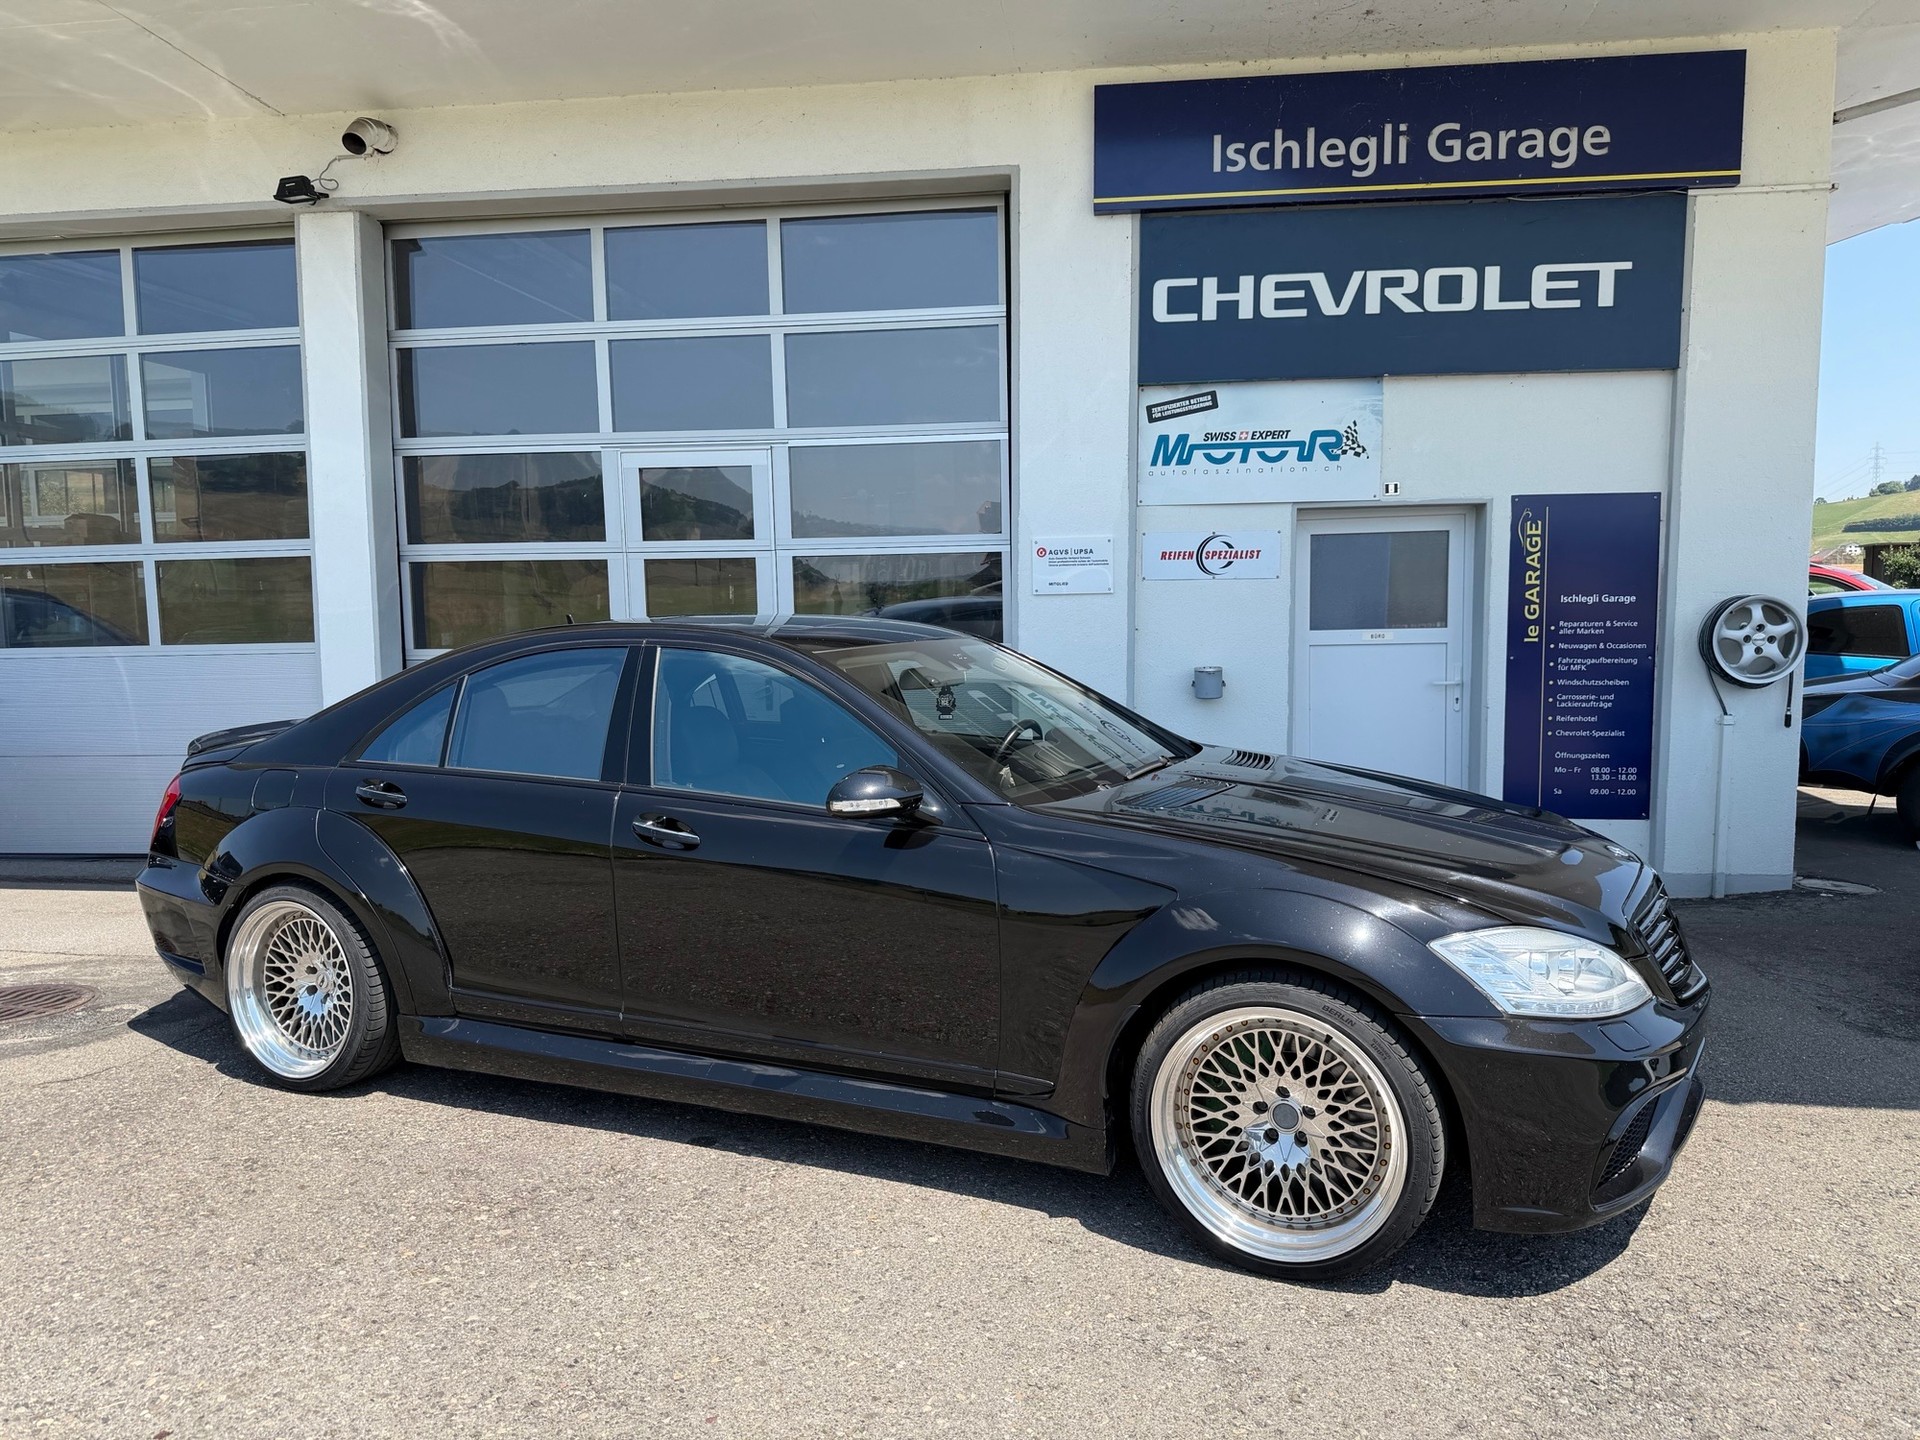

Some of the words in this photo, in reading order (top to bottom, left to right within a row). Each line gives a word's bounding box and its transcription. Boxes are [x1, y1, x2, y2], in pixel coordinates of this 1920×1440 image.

[1212, 123, 1407, 178] Ischlegli
[1428, 122, 1612, 170] Garage
[1152, 261, 1633, 323] CHEVROLET
[1203, 431, 1237, 442] SWISS
[1250, 430, 1291, 441] EXPERT
[1150, 429, 1344, 467] MOTOR
[1148, 464, 1342, 477] autofaszination.ch
[1048, 548, 1069, 556] AGVS
[1160, 550, 1195, 561] REIFEN
[1204, 549, 1262, 560] SPEZIALIST
[1524, 520, 1542, 620] GARAGE
[1560, 594, 1599, 604] Ischlegli
[1602, 594, 1637, 604] Garage
[1559, 620, 1604, 628] Reparaturen
[1523, 625, 1539, 642] le
[1558, 642, 1597, 650] Neuwagen
[1557, 657, 1638, 665] Fahrzeugaufbereitung
[1556, 701, 1613, 709] Lackieraufträge
[1555, 730, 1626, 738] Chevrolet-Spezialist
[1554, 751, 1610, 760] Öffnungszeiten
[1321, 1004, 1357, 1027] BERLIN
